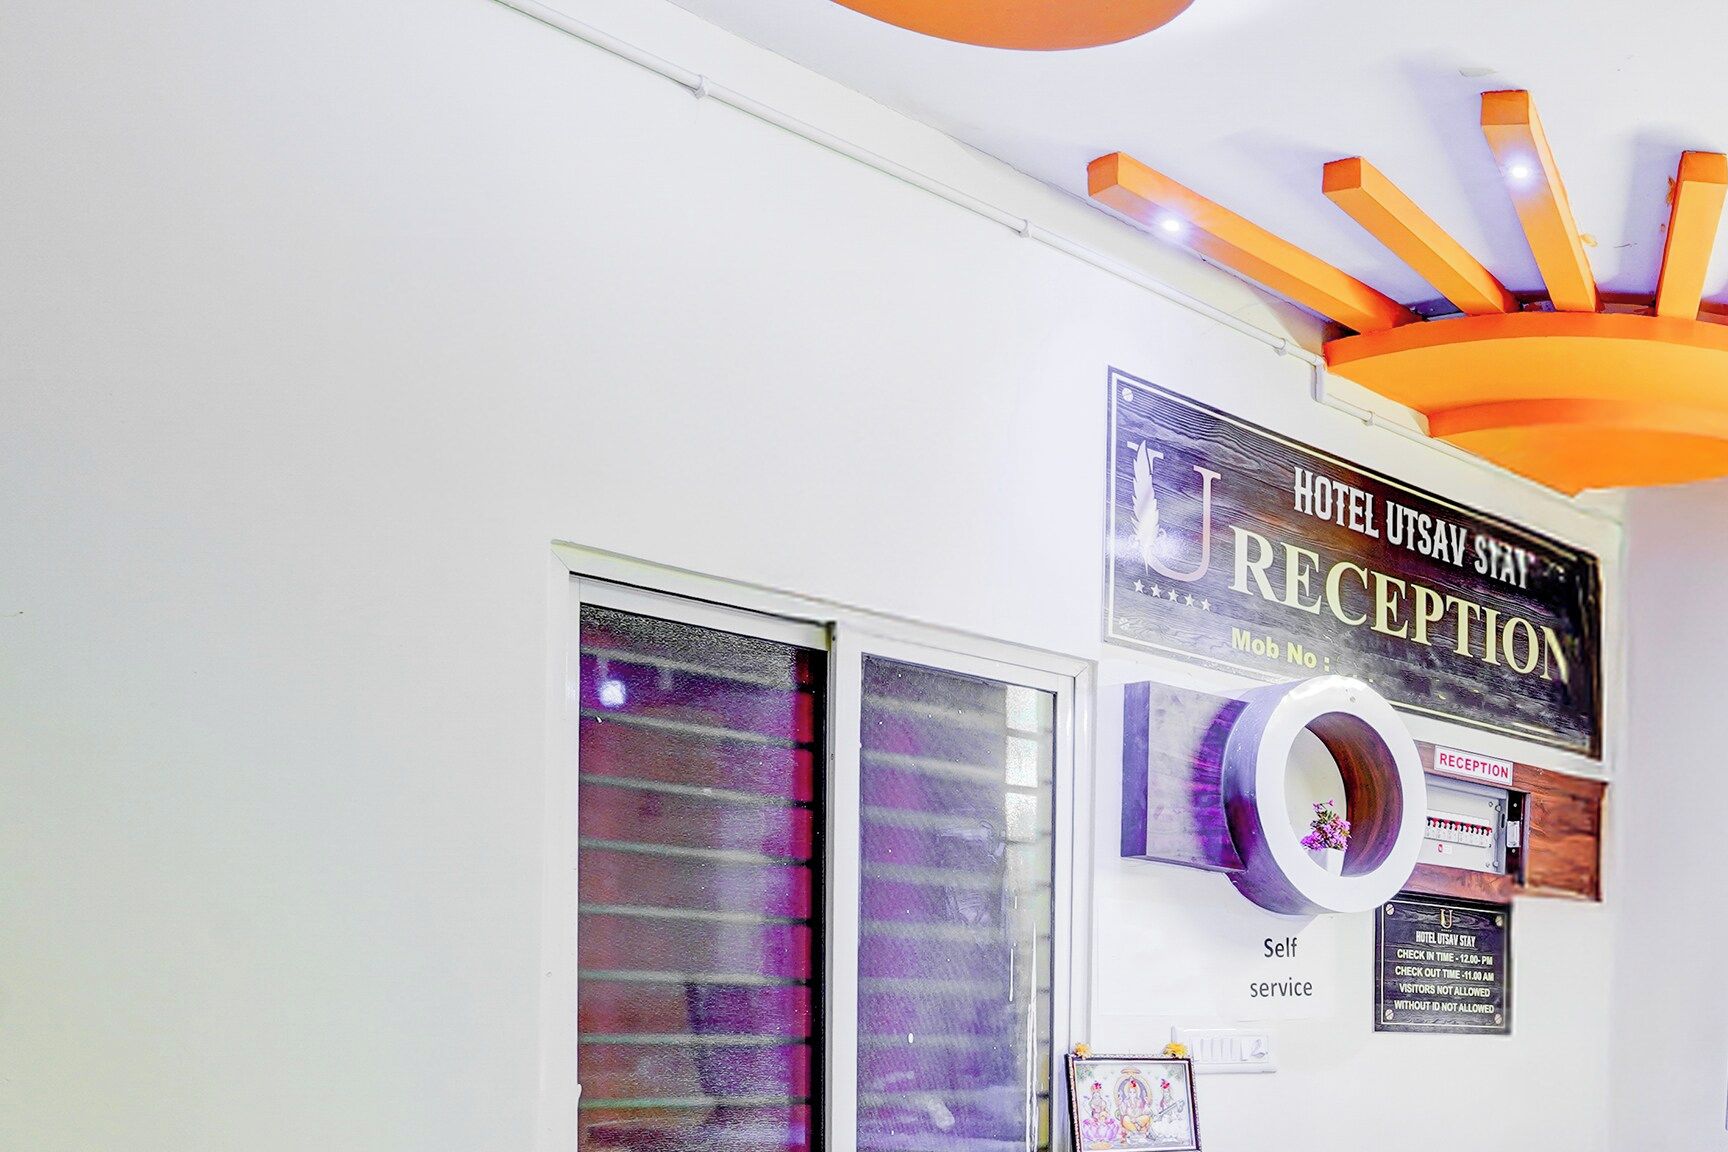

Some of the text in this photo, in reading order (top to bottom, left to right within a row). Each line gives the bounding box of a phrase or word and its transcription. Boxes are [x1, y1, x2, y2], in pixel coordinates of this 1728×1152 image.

[1293, 466, 1531, 590] HOTEL UTSAV STAY
[1229, 524, 1569, 684] RECEPTION
[1231, 627, 1280, 659] Mob
[1439, 752, 1509, 779] RECEPTION
[1263, 936, 1298, 958] Self
[1415, 930, 1476, 948] HOTEL UTSAV STAY
[1396, 948, 1426, 960] CHECK
[1426, 951, 1435, 961] IN
[1436, 952, 1455, 962] TIME
[1481, 956, 1494, 966] PM
[1394, 965, 1424, 977] CHECK
[1424, 968, 1441, 978] OUT
[1441, 969, 1461, 979] TIME
[1482, 972, 1495, 982] AM
[1249, 976, 1313, 998] service
[1399, 982, 1491, 998] VISITORS NOT ALLOWED
[1393, 1000, 1496, 1014] WITHOUT ID NOT ALLOWED
